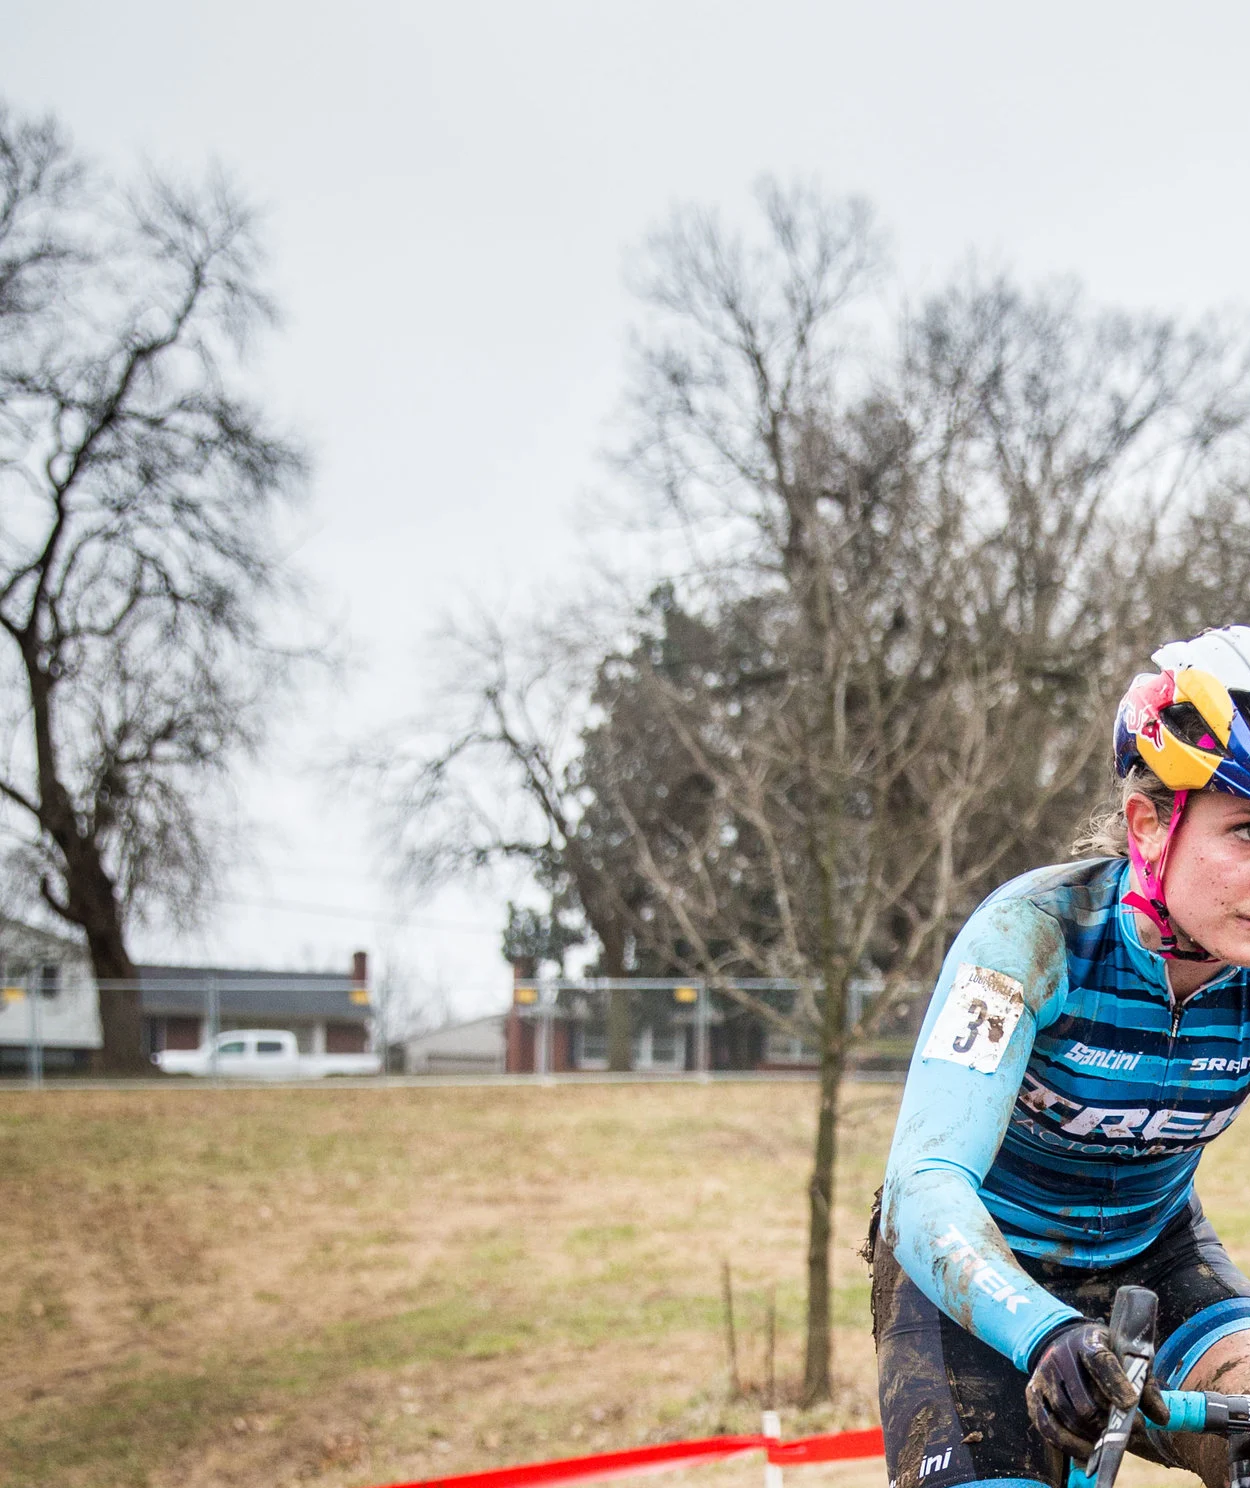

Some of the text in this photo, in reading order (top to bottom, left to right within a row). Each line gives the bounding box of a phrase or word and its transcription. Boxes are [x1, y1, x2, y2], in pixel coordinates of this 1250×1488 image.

[969, 973, 1014, 996] LOUILLE
[953, 999, 988, 1053] 3
[1064, 1042, 1144, 1071] Santini
[935, 1223, 1032, 1315] TREK
